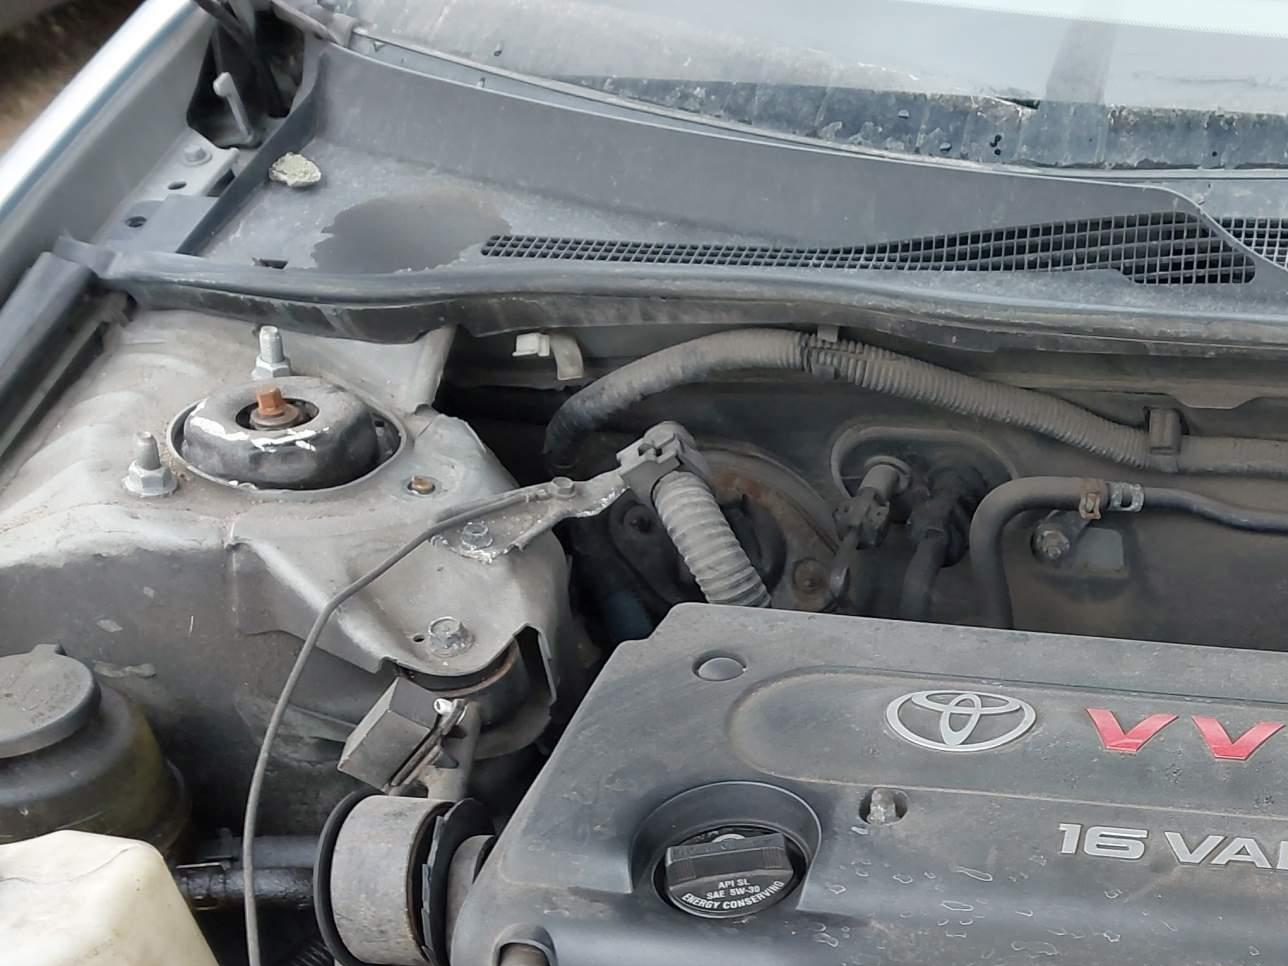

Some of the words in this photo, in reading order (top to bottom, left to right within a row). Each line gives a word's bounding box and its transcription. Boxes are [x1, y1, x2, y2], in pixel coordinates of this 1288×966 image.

[1058, 823, 1149, 861] 16
[681, 893, 721, 909] ENERGY
[722, 880, 785, 909] CONSERVING
[706, 891, 725, 900] SAE
[730, 885, 760, 896] 5W-30
[718, 881, 735, 889] API
[736, 879, 751, 887] SL
